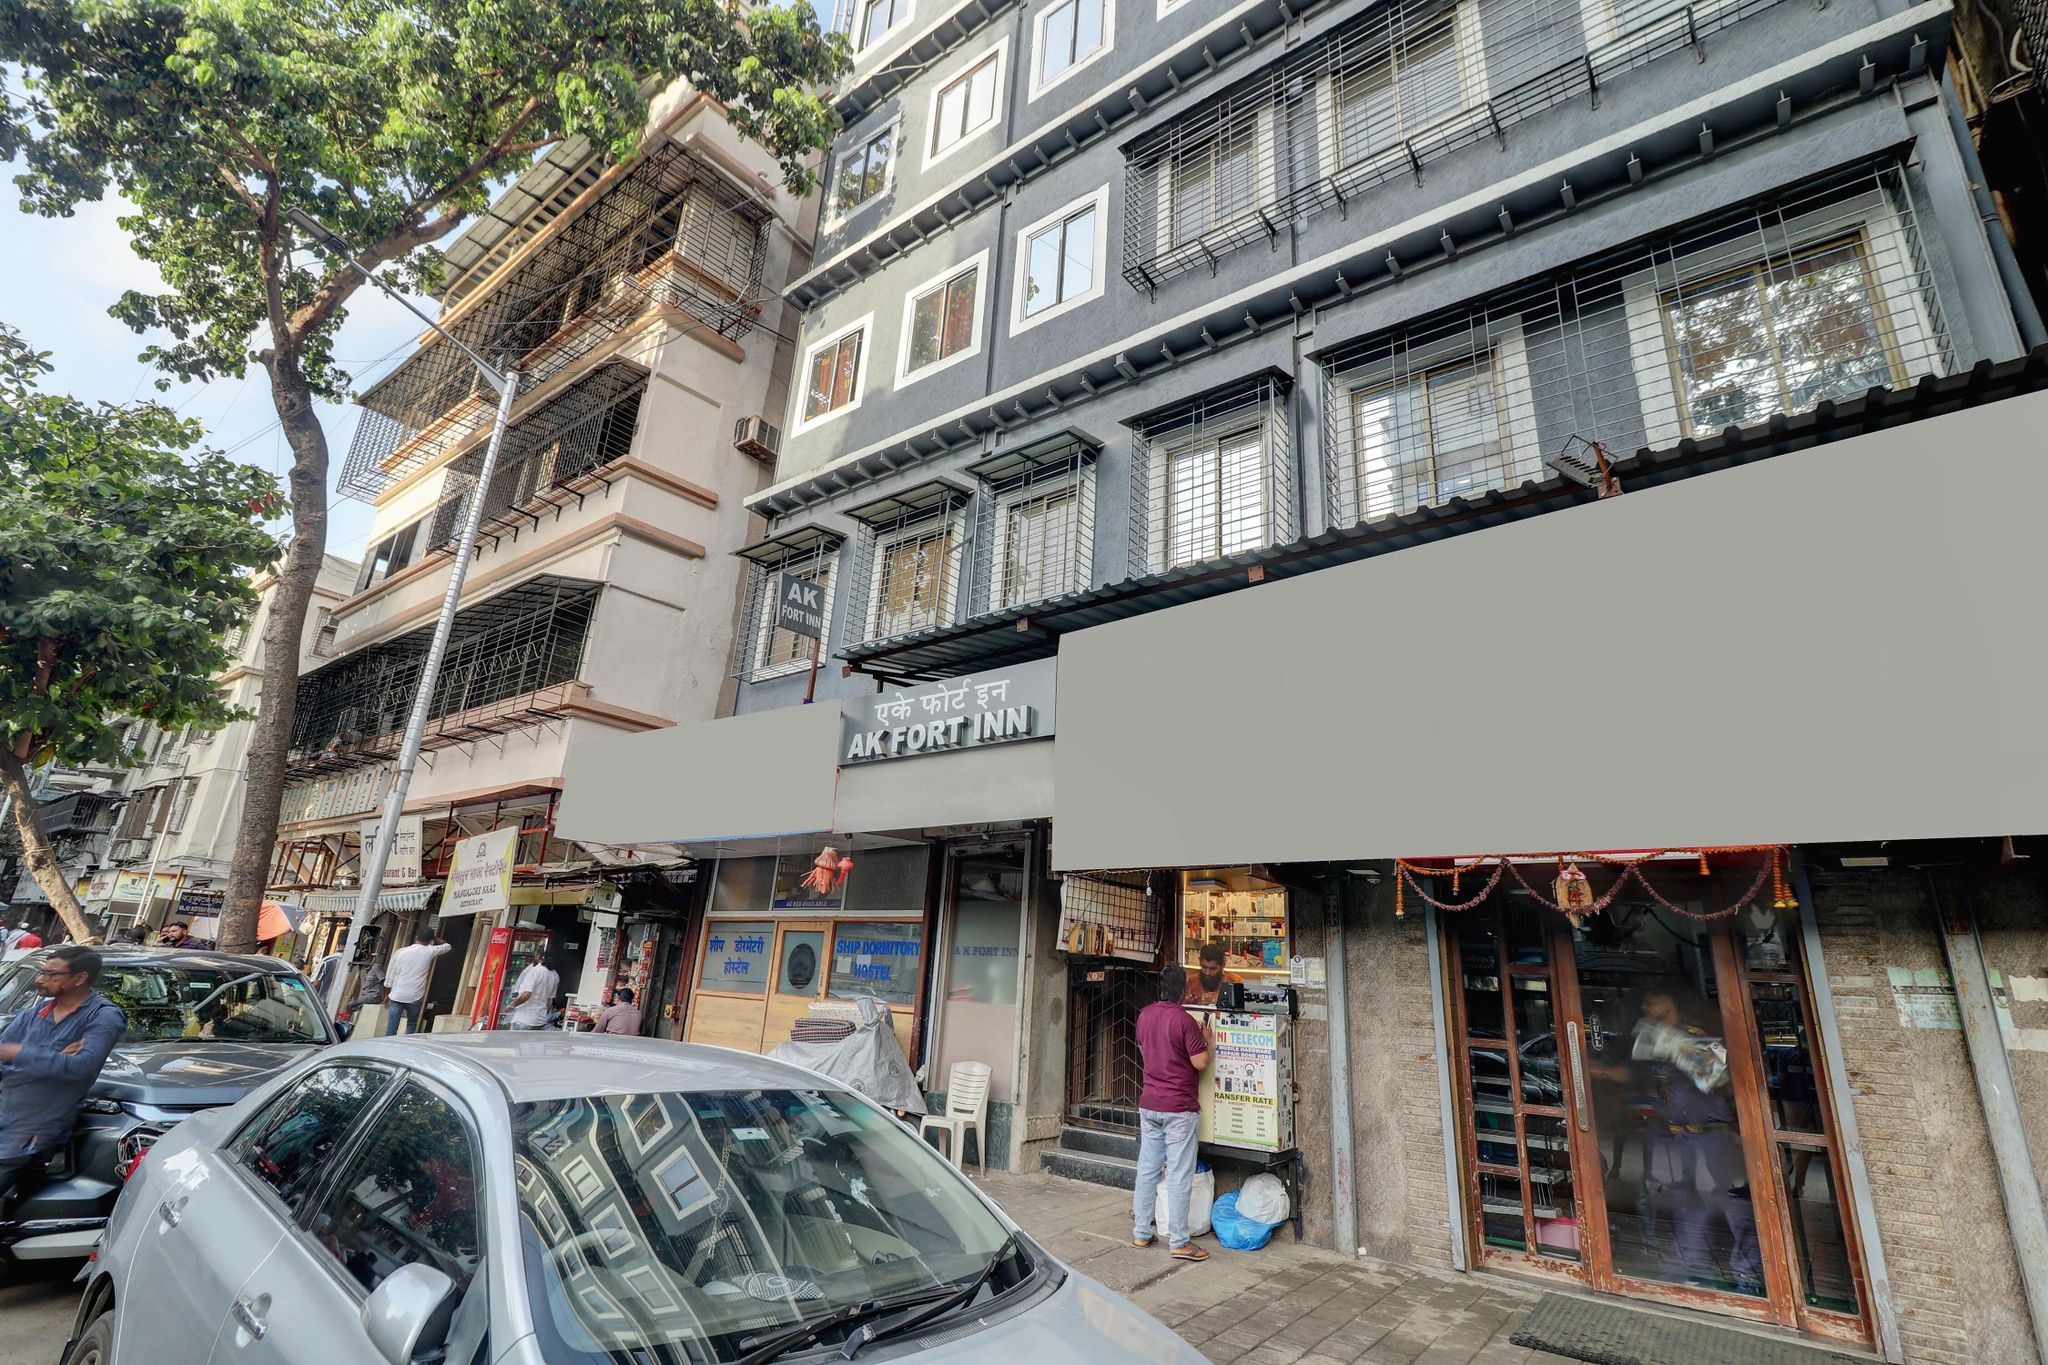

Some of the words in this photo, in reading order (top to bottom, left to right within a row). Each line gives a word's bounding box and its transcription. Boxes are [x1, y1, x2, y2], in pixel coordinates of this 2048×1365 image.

[787, 583, 818, 609] AK
[782, 604, 804, 622] FORT
[806, 612, 821, 629] INN
[874, 692, 915, 726] एके
[919, 678, 972, 715] फोर्ट
[975, 679, 1010, 709] इन
[847, 729, 889, 760] AK
[891, 716, 969, 754] FORT
[973, 704, 1032, 743] INN
[408, 867, 417, 878] Bar
[709, 936, 725, 953] शीप
[836, 940, 861, 954] SHIP
[862, 940, 921, 956] DORMITORY
[972, 946, 999, 957] FORT
[1001, 947, 1019, 957] INN
[723, 957, 750, 976] होस्टेल
[853, 964, 892, 981] HOSTEL
[1230, 1032, 1273, 1047] TELECOM
[1591, 1017, 1602, 1048] PULL
[1240, 1047, 1271, 1055] HARDWARE
[1214, 1092, 1251, 1103] RANSFER
[1252, 1096, 1273, 1105] RATE
